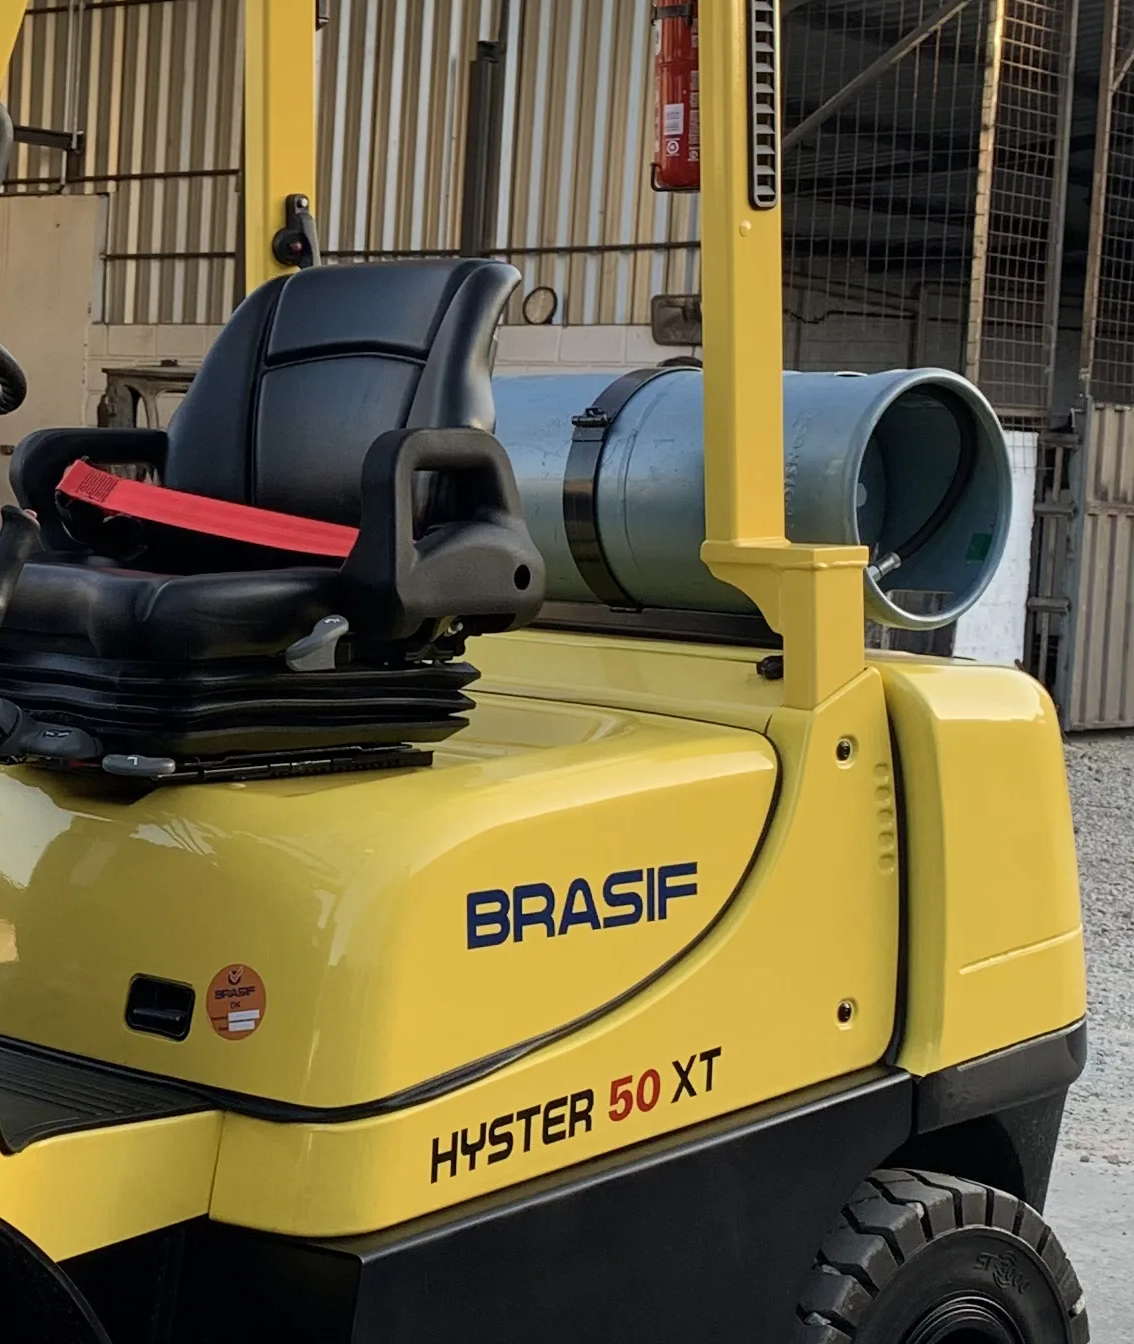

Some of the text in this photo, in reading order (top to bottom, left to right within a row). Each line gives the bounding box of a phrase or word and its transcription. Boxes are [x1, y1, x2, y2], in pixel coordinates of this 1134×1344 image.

[466, 861, 698, 950] BRASIF
[430, 1046, 722, 1184] HYSTER 50 XT
